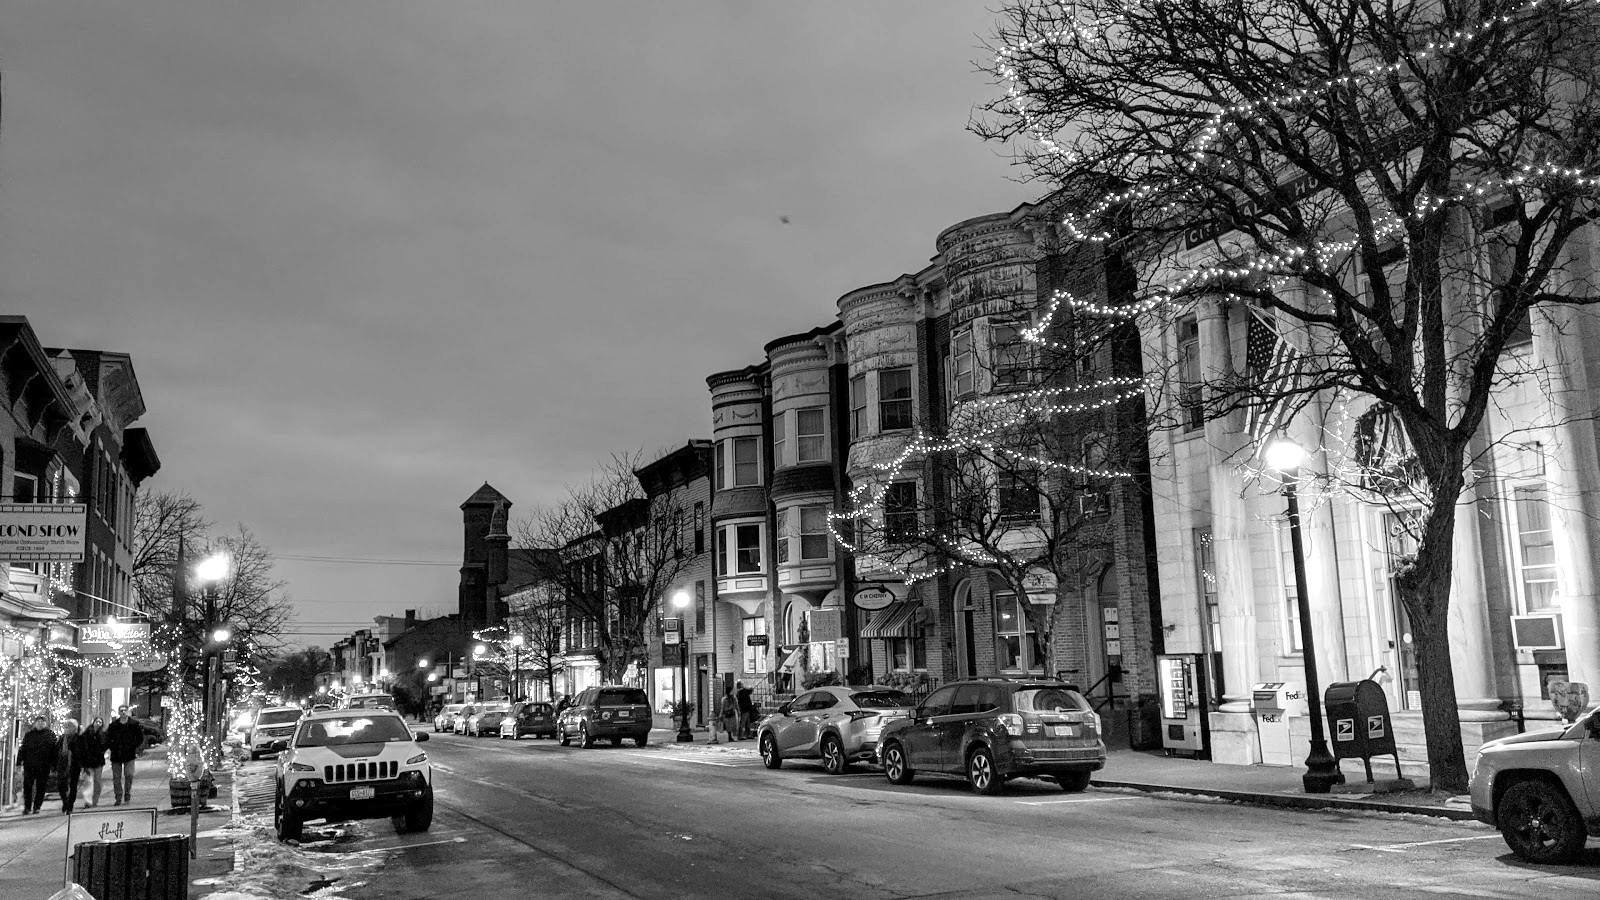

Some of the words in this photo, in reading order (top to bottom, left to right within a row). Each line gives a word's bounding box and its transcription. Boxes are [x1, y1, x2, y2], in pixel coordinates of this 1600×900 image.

[40, 525, 80, 537] SHOW
[82, 627, 111, 640] Baba
[1285, 690, 1307, 701] FedEx
[1262, 714, 1282, 723] FedEx
[98, 821, 124, 839] fluff
